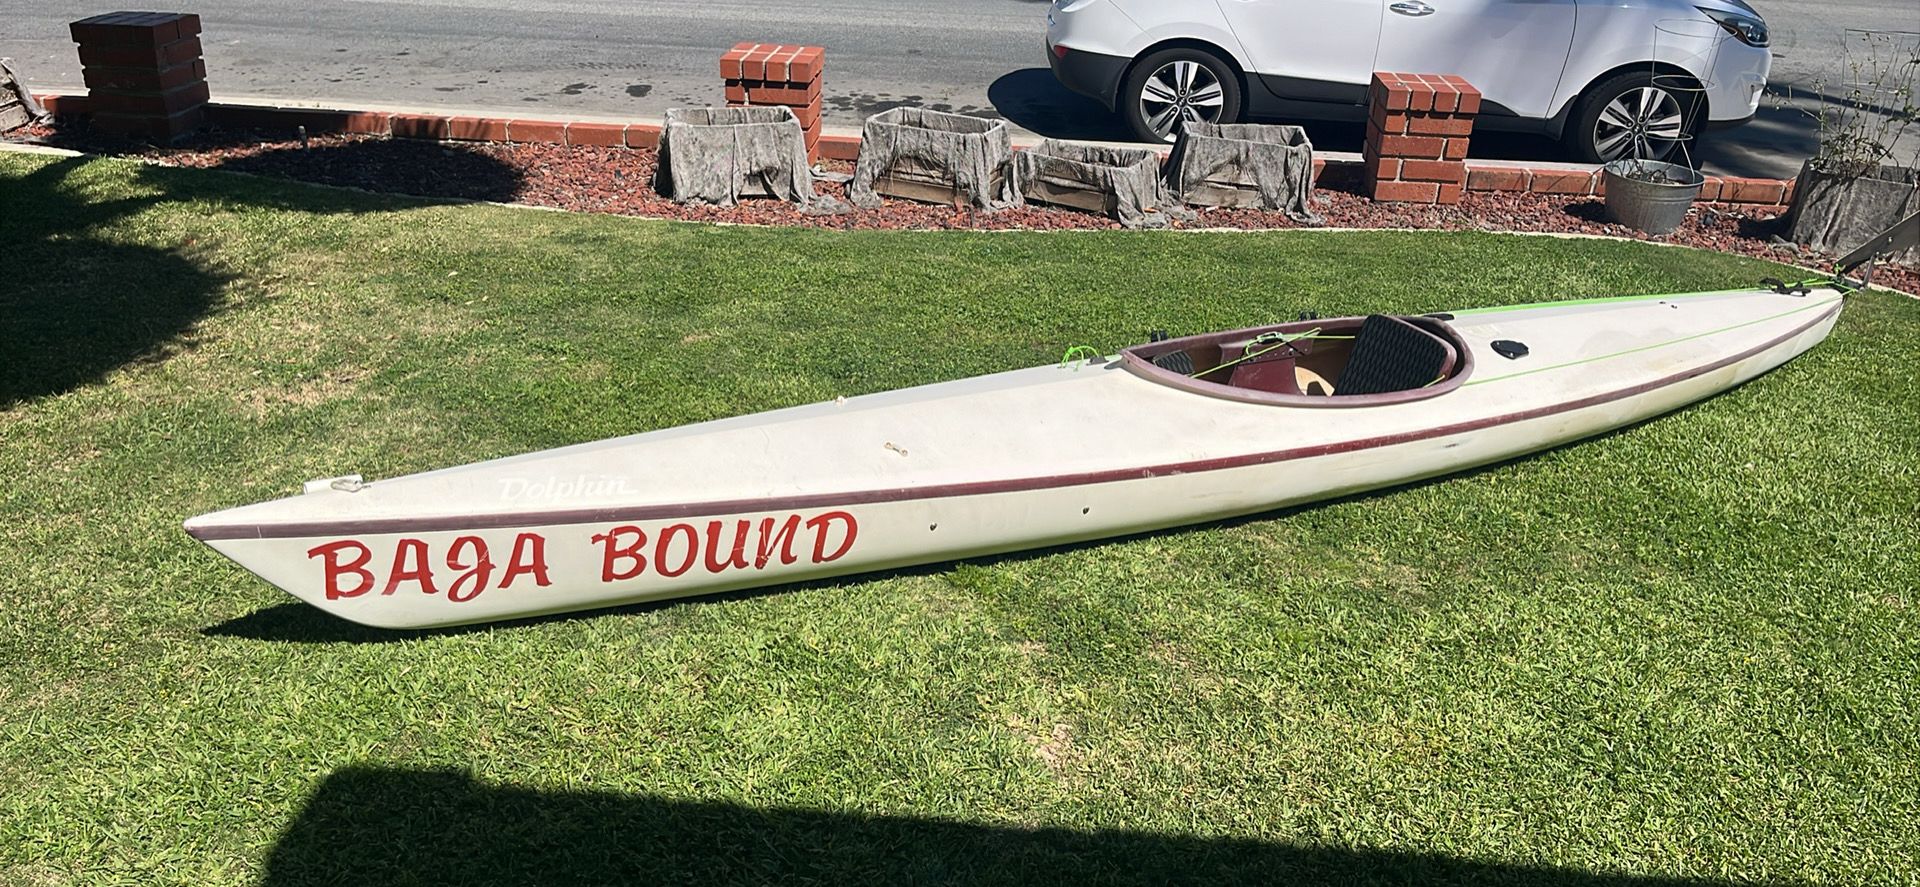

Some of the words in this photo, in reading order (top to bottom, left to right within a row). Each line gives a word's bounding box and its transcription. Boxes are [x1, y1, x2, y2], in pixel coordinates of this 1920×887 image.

[498, 474, 639, 501] Dolphin
[307, 532, 552, 602] BAJA
[591, 510, 859, 583] BOUND
